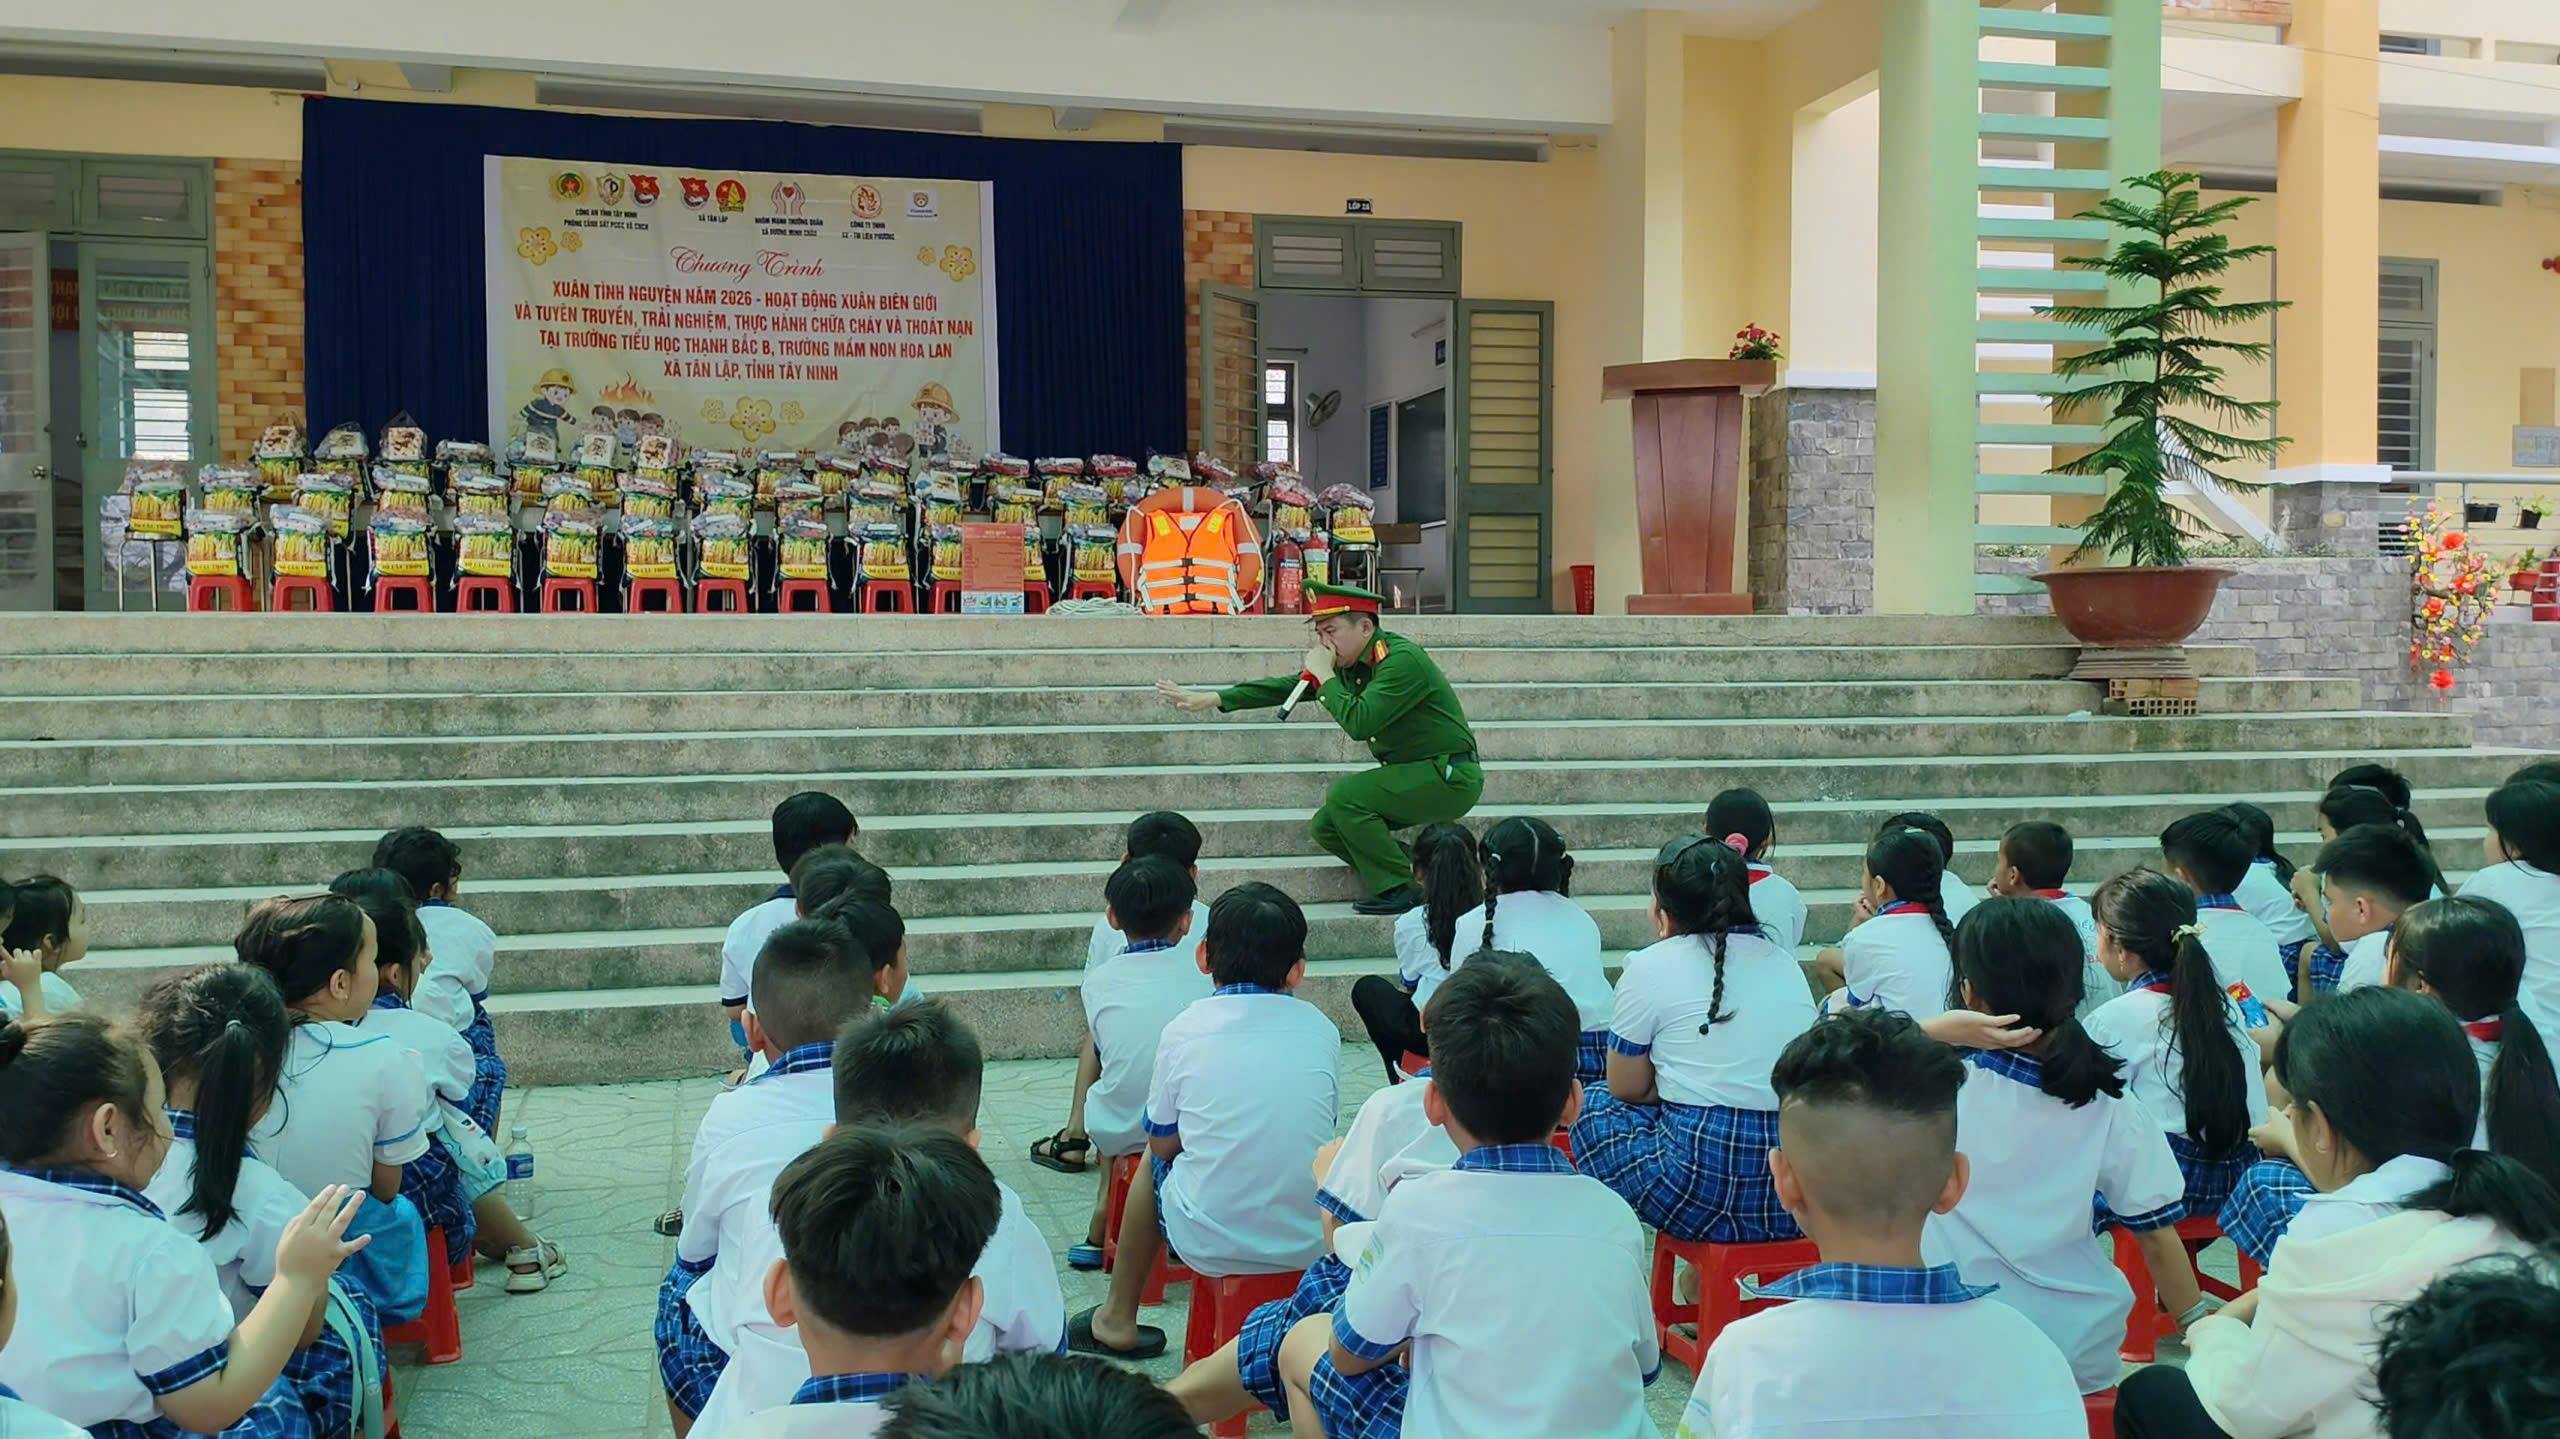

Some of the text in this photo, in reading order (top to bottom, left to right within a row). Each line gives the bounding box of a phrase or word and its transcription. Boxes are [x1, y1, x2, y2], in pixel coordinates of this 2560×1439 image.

[670, 246, 824, 284] Chương Trình
[553, 279, 589, 299] XUÂN
[594, 281, 624, 301] TÌNH
[629, 284, 681, 308] NGUYỆN
[685, 285, 716, 305] NĂM
[721, 290, 751, 306] 2026
[765, 291, 797, 313] HOẠT
[802, 289, 837, 312] ĐỘNG
[841, 290, 875, 310] XUÂN
[880, 292, 909, 311] BIÊN
[913, 293, 937, 312] GIỚI
[514, 301, 973, 338] VÀ TUYÊN TRUYỀN, TRẢI NGHIỆM, THỰC HÀNH CHỮA CHÁY VÀ THOÁT NẠN
[539, 328, 952, 359] TẠI TRƯỜNG TIỂU HỌC THẠNH BẮC B, TRƯỜNG MẦM NON HOA LAN
[664, 358, 838, 382] XÃ TÂN LẬP, TỈNH TÂY NINH
